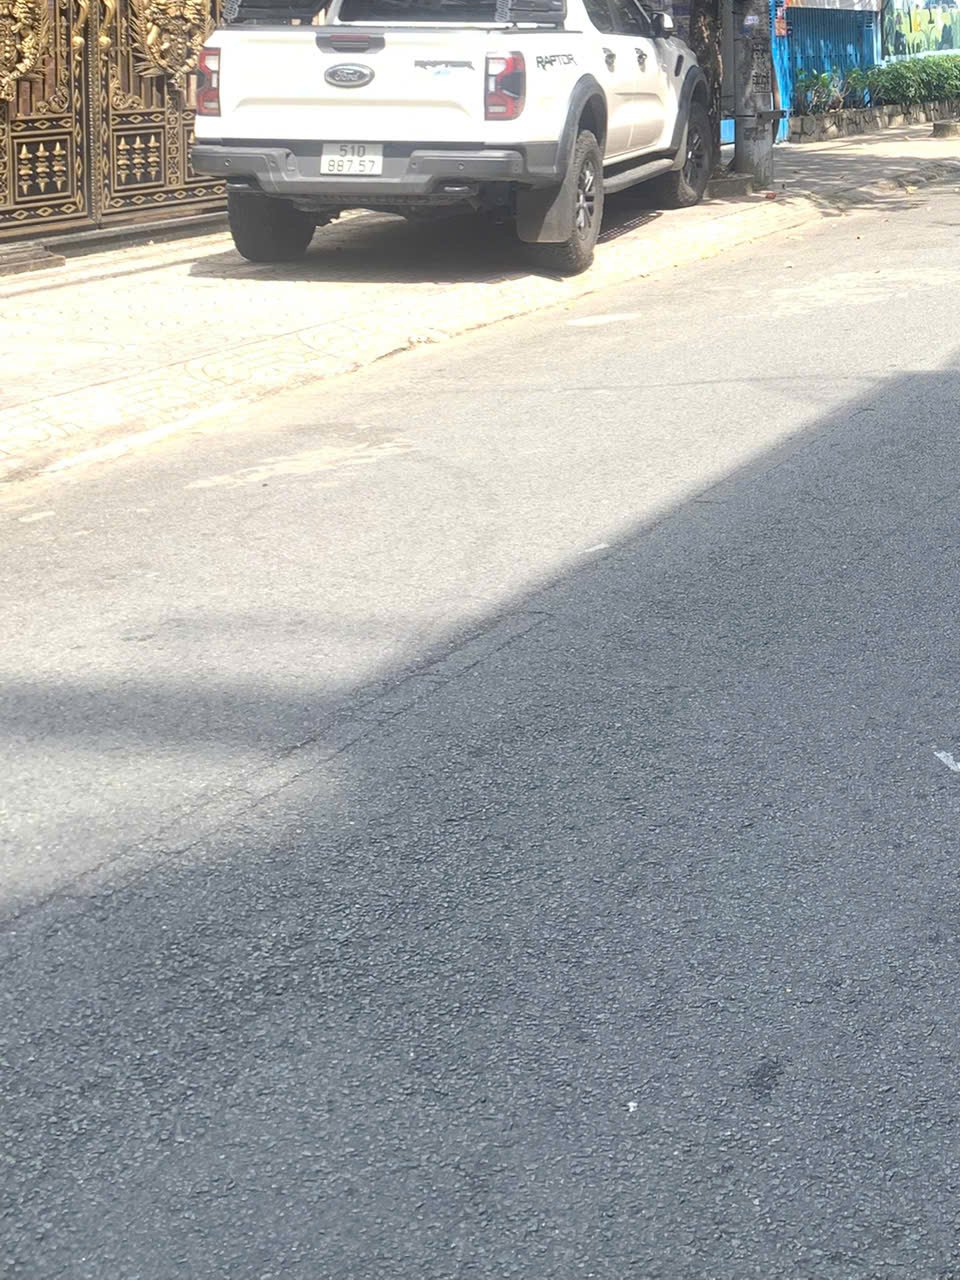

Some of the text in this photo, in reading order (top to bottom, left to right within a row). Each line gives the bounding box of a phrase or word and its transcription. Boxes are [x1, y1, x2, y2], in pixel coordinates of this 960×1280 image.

[536, 54, 577, 70] RAPTOR
[339, 144, 366, 158] 51D
[328, 159, 376, 172] 887.57
